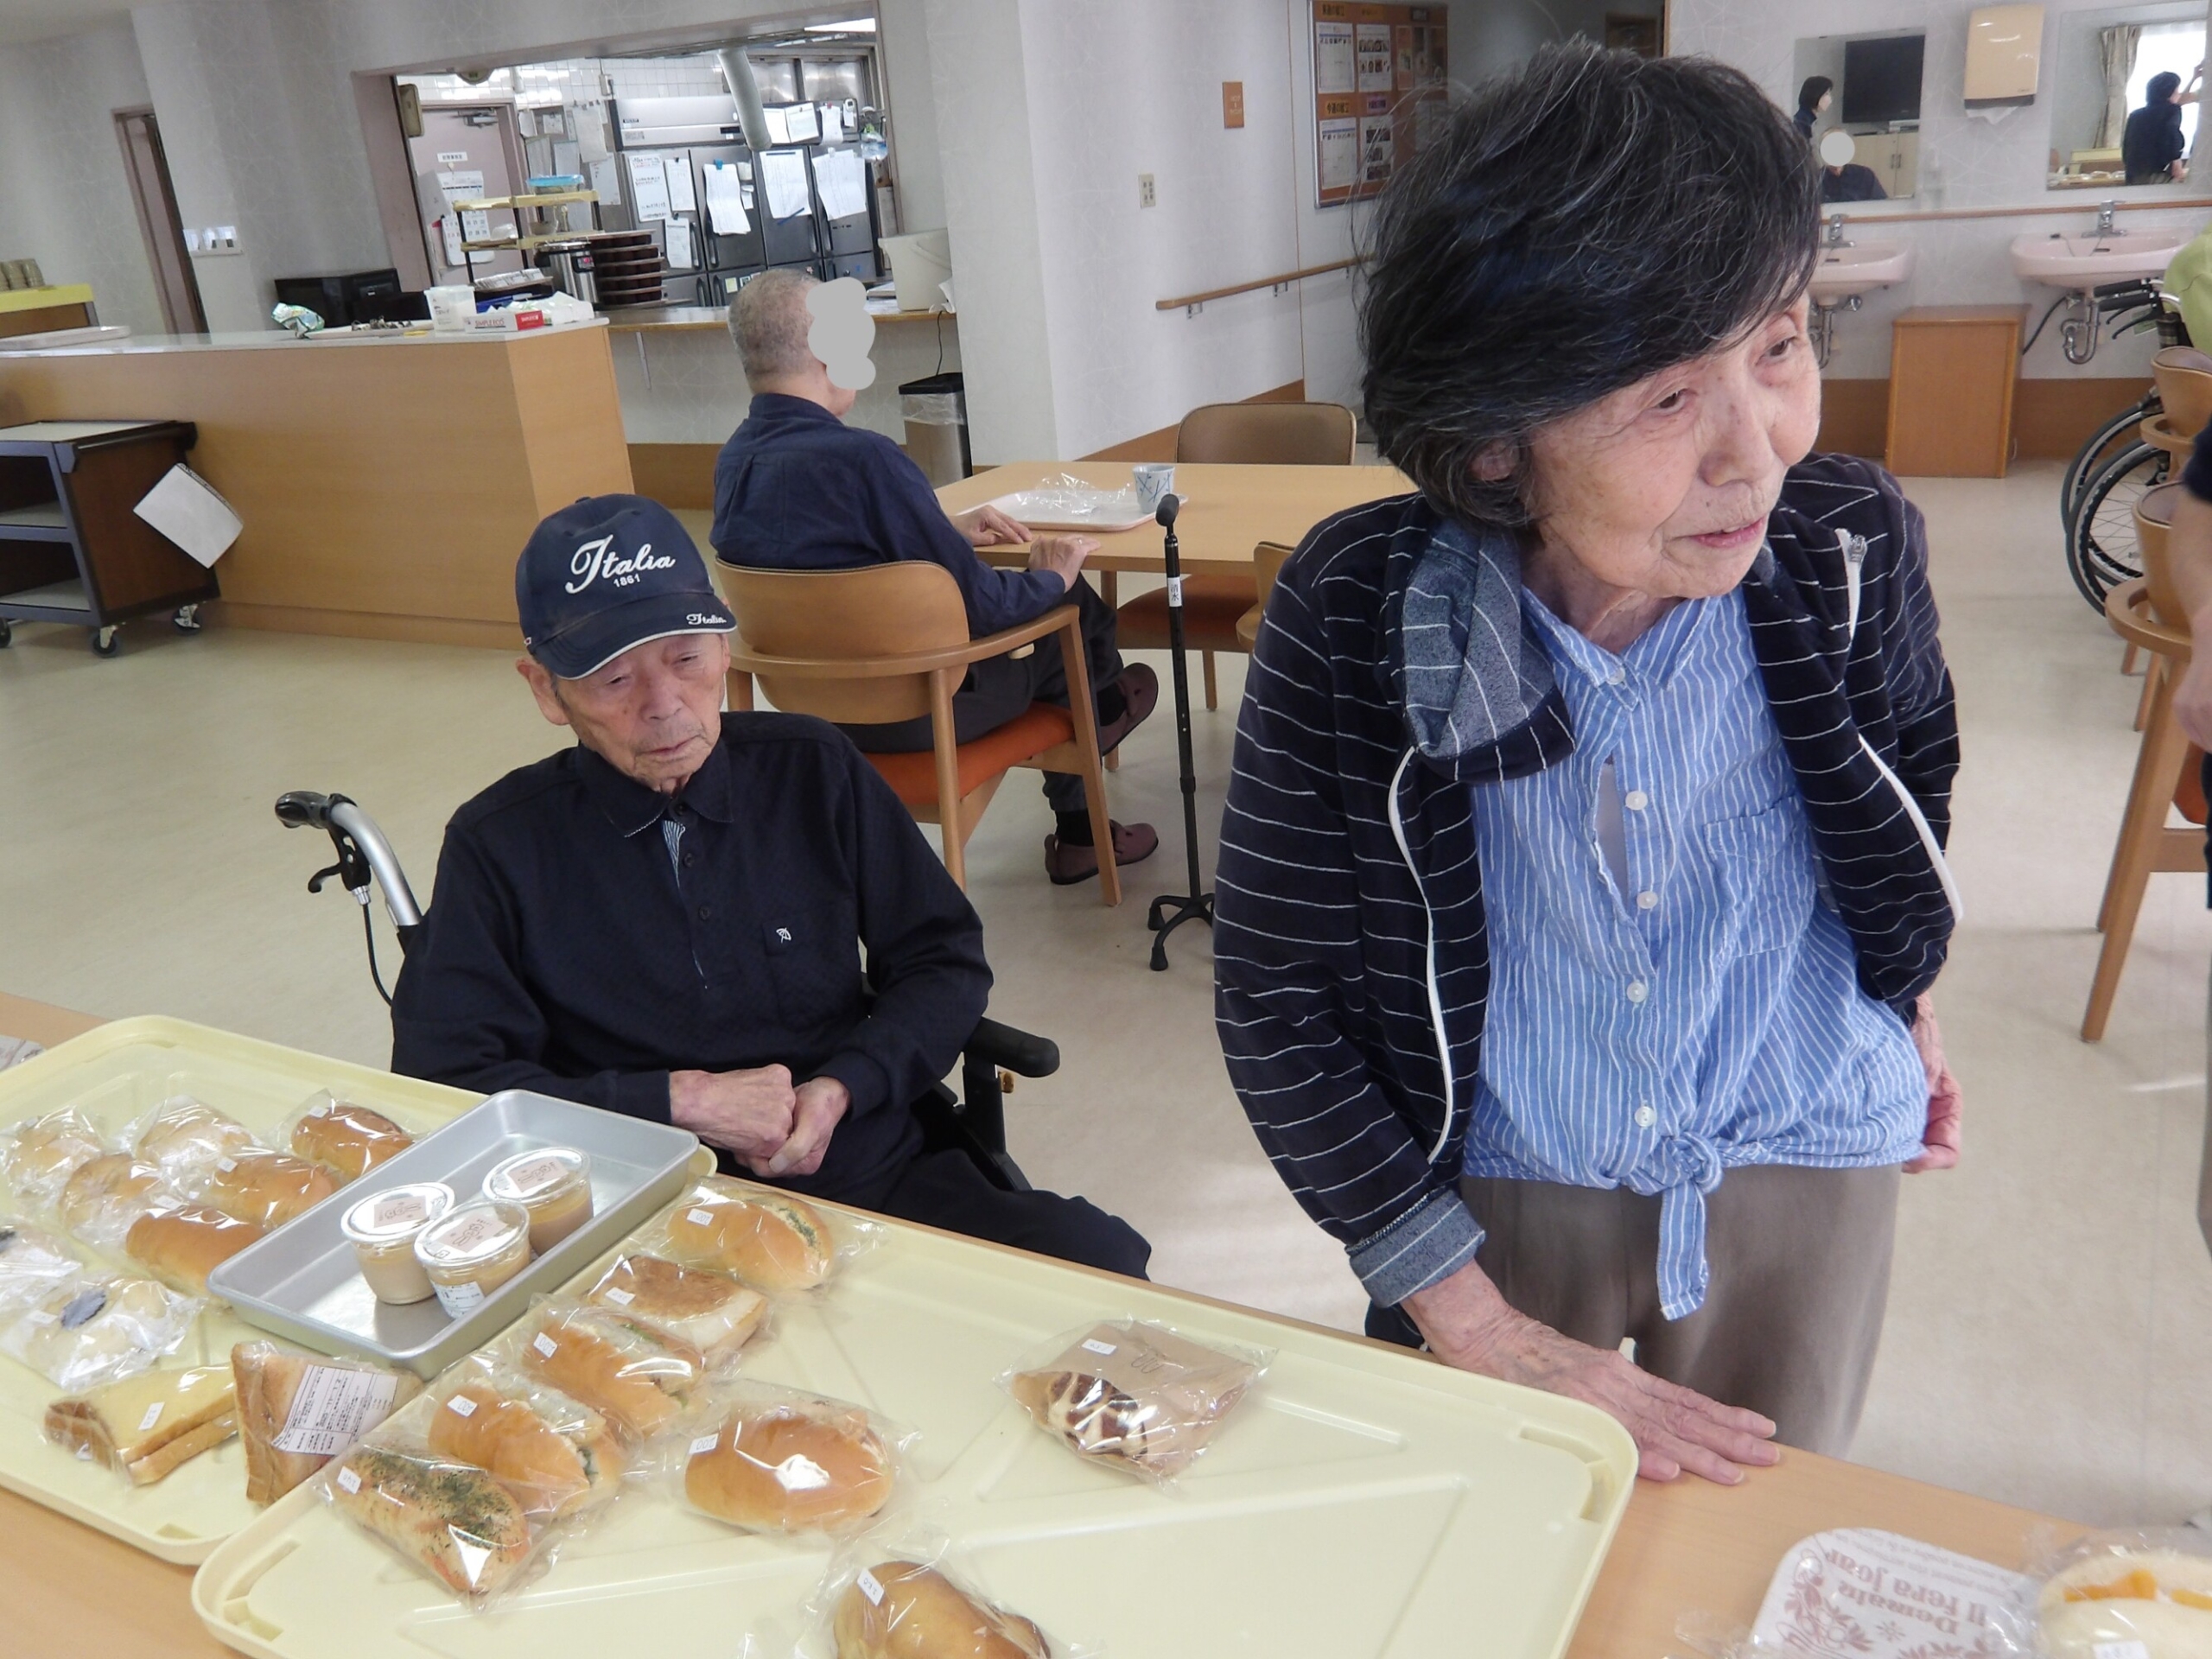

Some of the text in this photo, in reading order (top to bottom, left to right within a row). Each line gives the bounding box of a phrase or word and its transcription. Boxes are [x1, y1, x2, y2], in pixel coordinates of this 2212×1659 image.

[564, 534, 677, 594] Italia
[613, 573, 641, 588] 1861
[696, 1212, 710, 1224] 200
[538, 1337, 556, 1355] 200
[696, 1438, 715, 1451] 200
